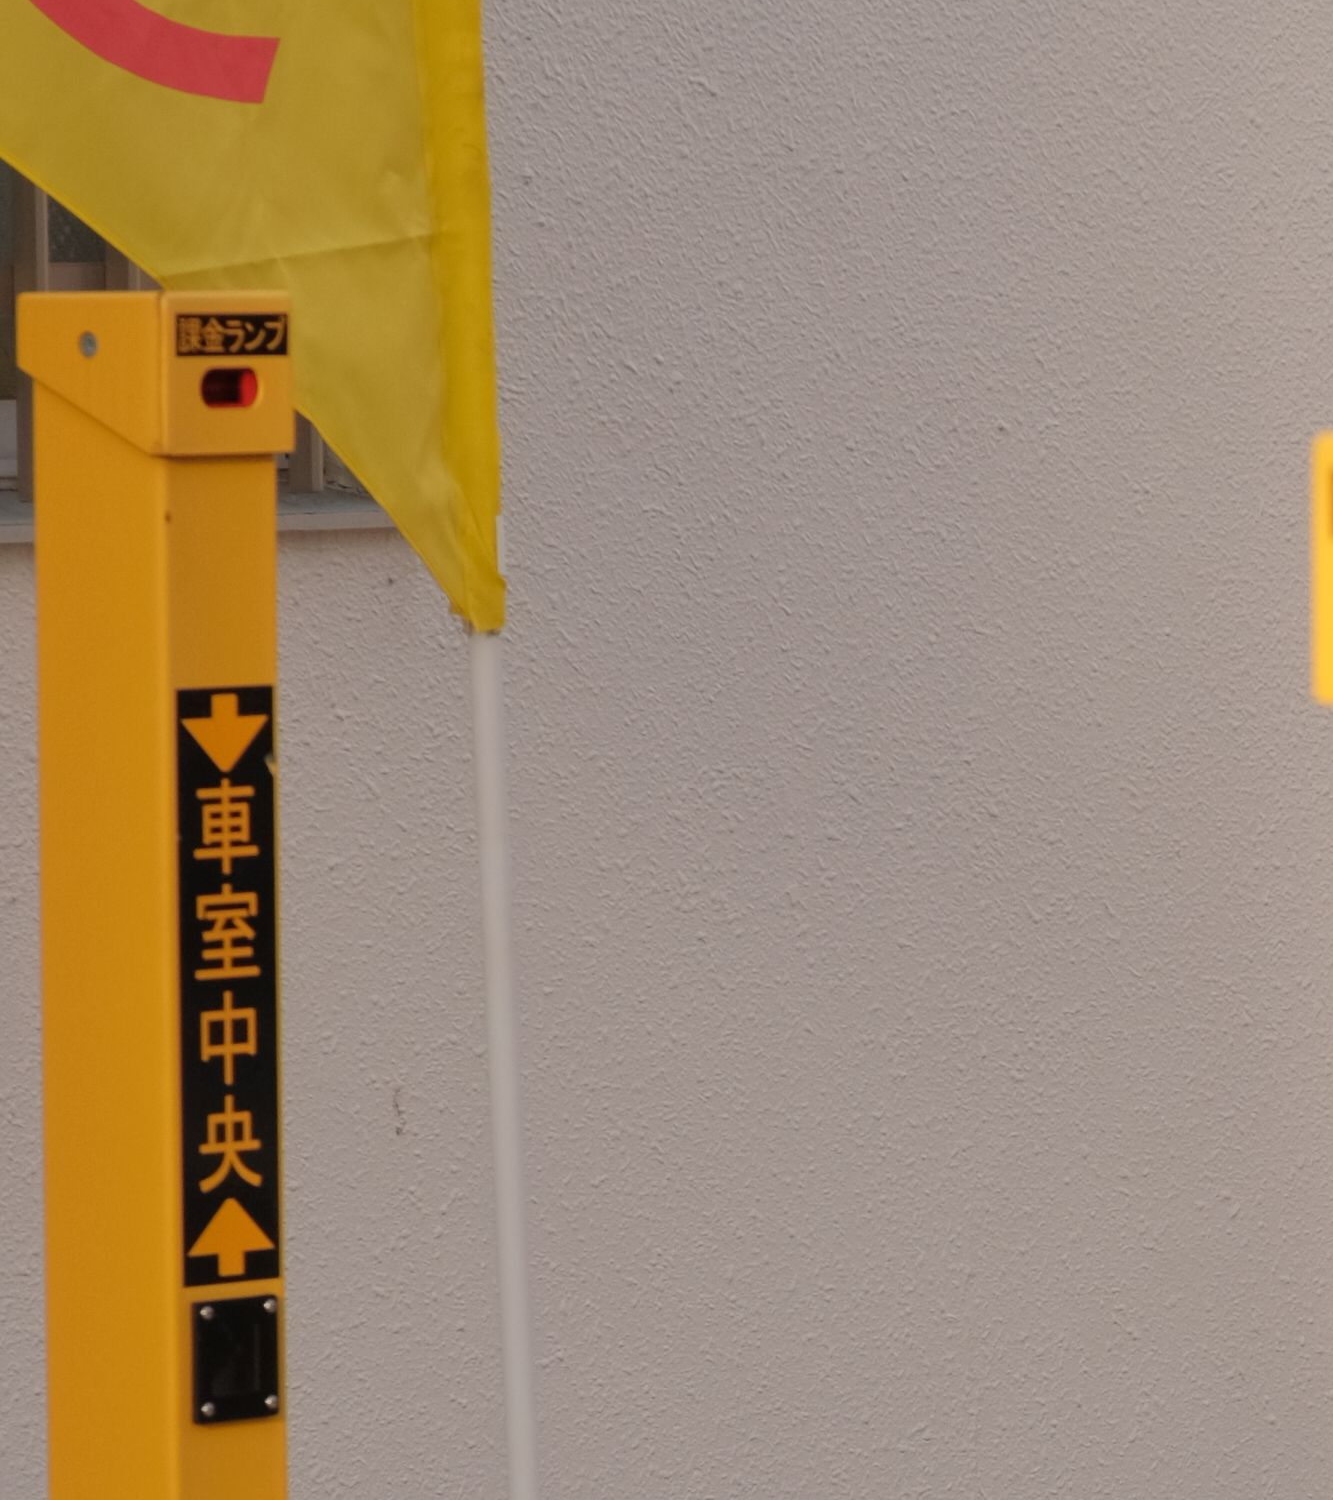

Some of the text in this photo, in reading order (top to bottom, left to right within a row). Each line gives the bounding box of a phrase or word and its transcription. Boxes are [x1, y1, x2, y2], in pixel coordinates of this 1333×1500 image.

[178, 316, 285, 354] 課金ランプ
[193, 778, 262, 1194] 車室中央
